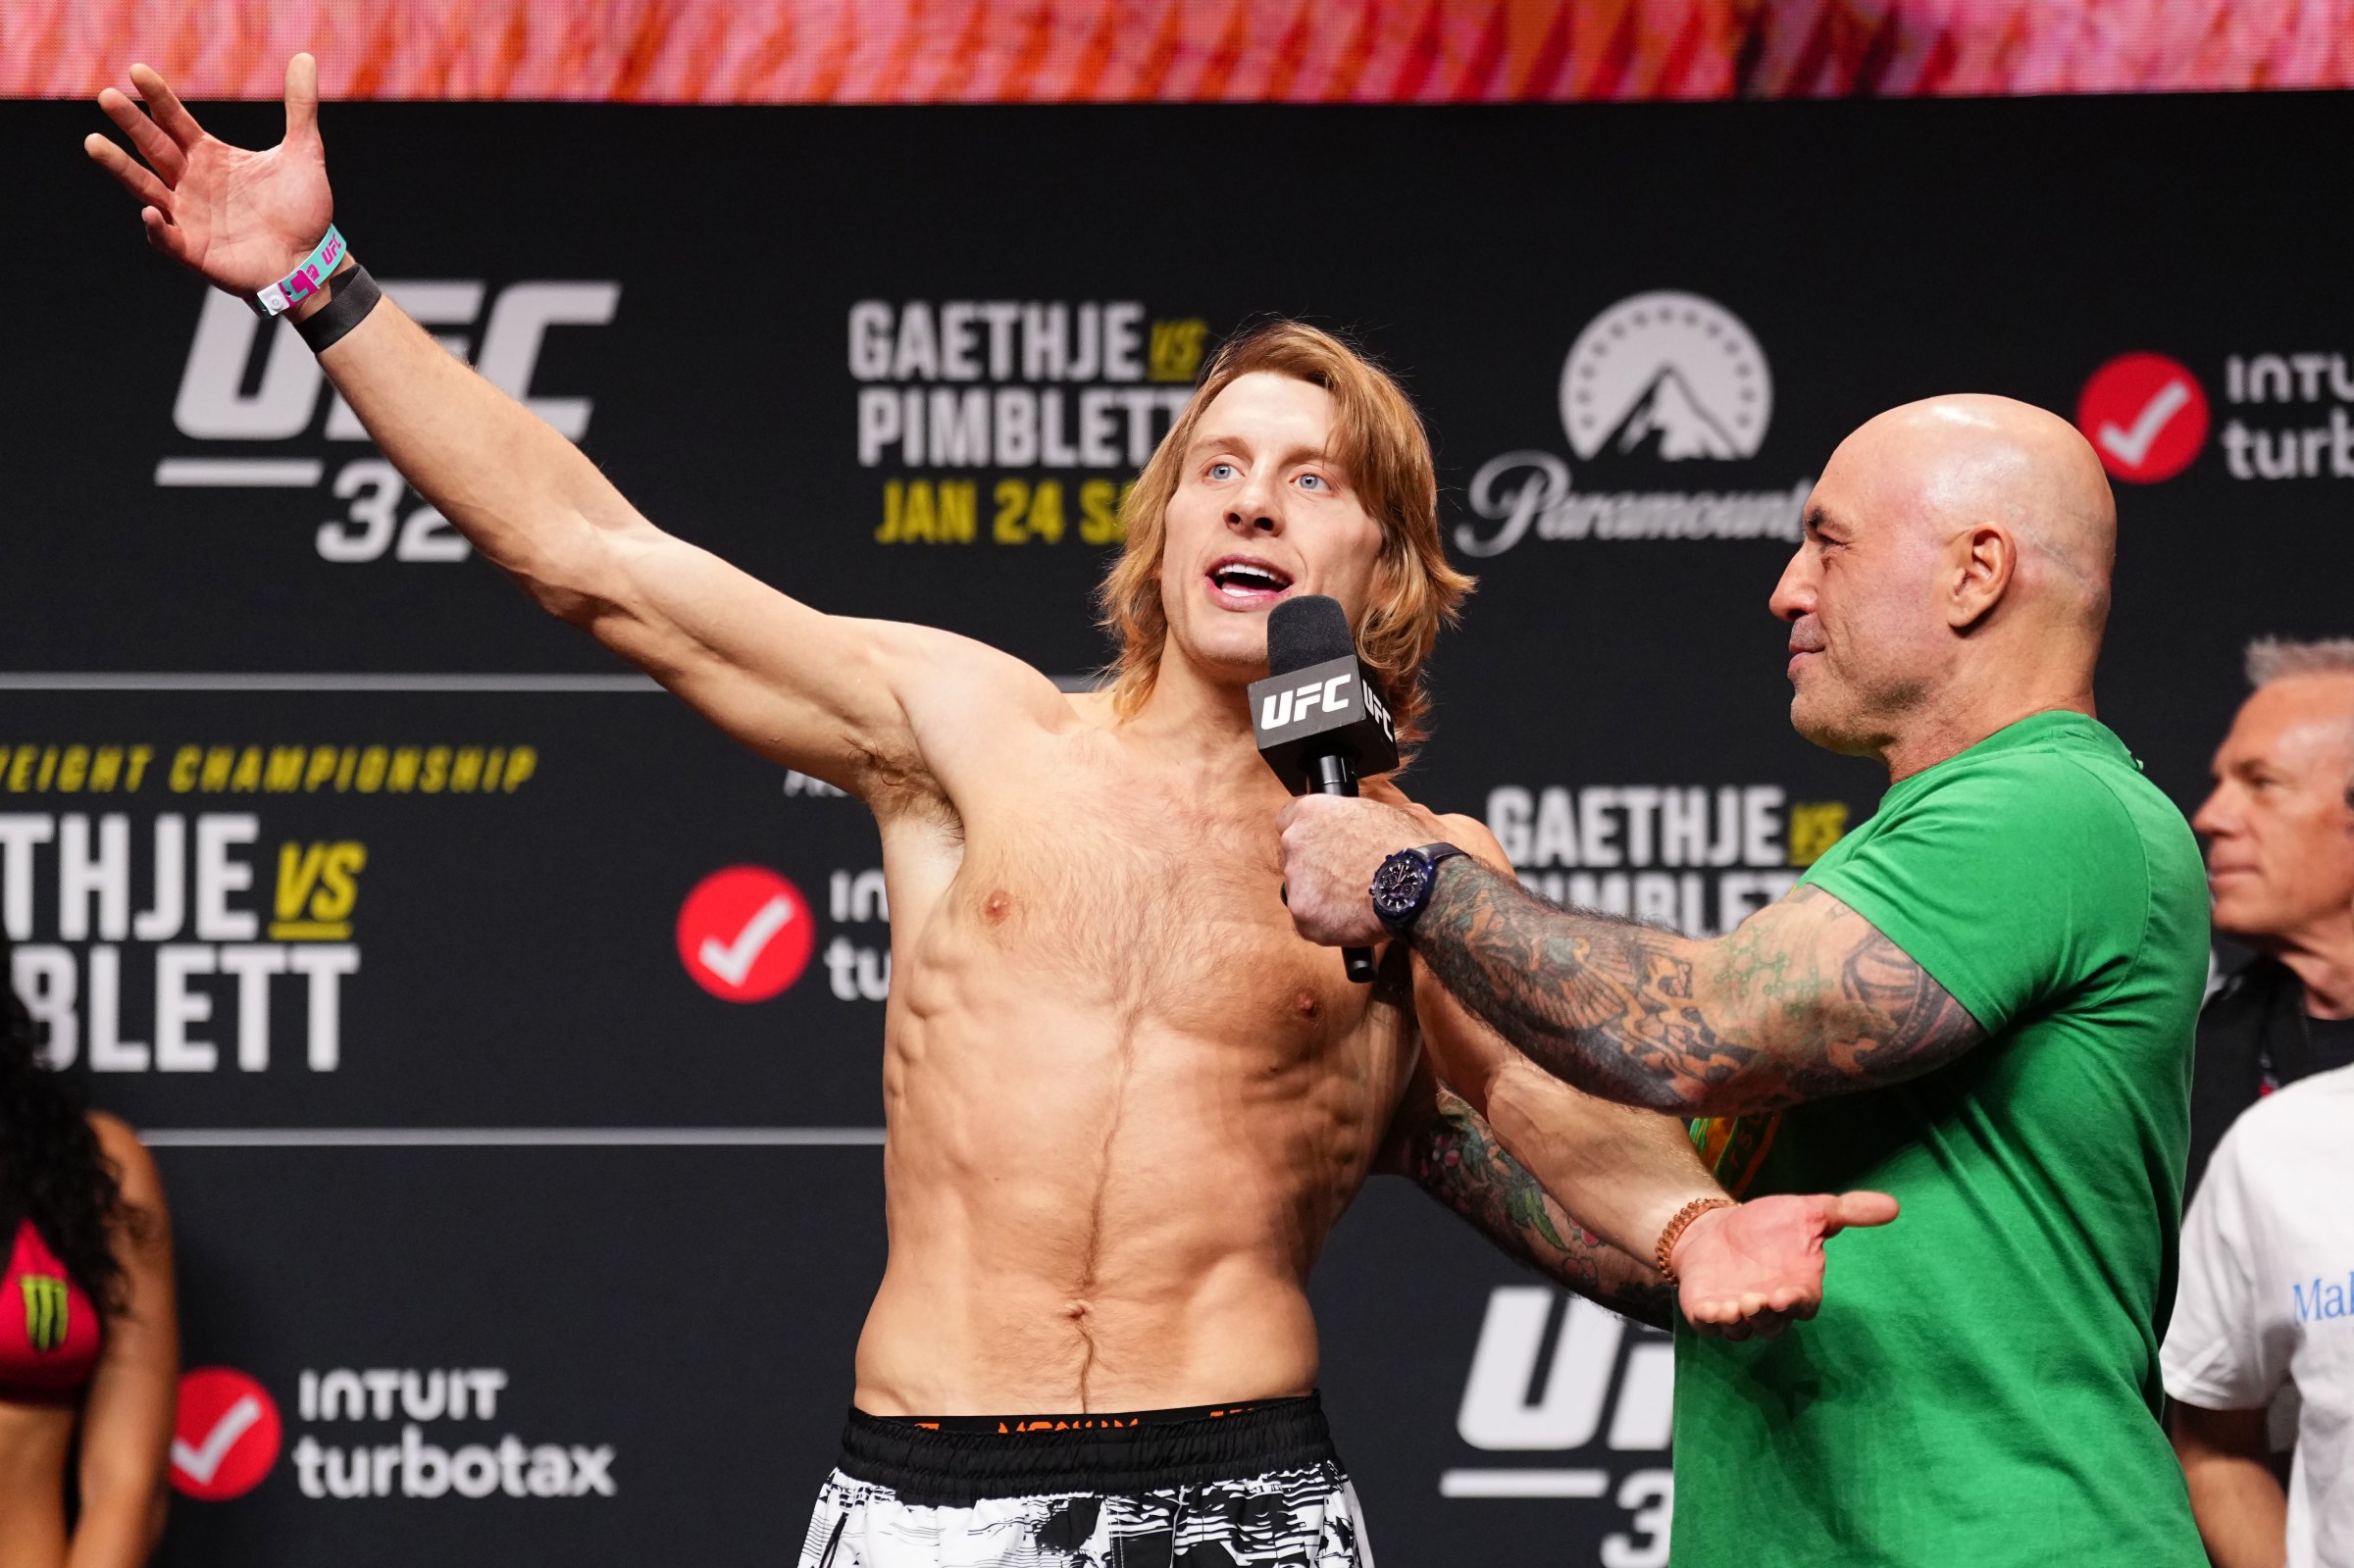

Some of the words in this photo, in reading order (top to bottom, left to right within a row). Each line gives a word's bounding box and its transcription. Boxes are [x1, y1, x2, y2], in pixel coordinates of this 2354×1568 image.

[847, 301, 1146, 381] GAETHJE
[1148, 319, 1207, 381] VS
[875, 480, 977, 544] JAN
[993, 480, 1065, 544] 24
[1453, 449, 1812, 557] Paramount
[1260, 673, 1352, 731] UFC
[1361, 679, 1394, 743] UFC
[0, 745, 154, 793] EIGHT
[169, 745, 538, 793] CHAMPIONSHIP
[1487, 785, 1786, 868] GAETHJE
[0, 813, 259, 941] THJE
[271, 842, 367, 927] VS
[10, 944, 360, 1072] BLETT
[2293, 1269, 2354, 1327] Ma
[294, 1425, 617, 1498] turbotax
